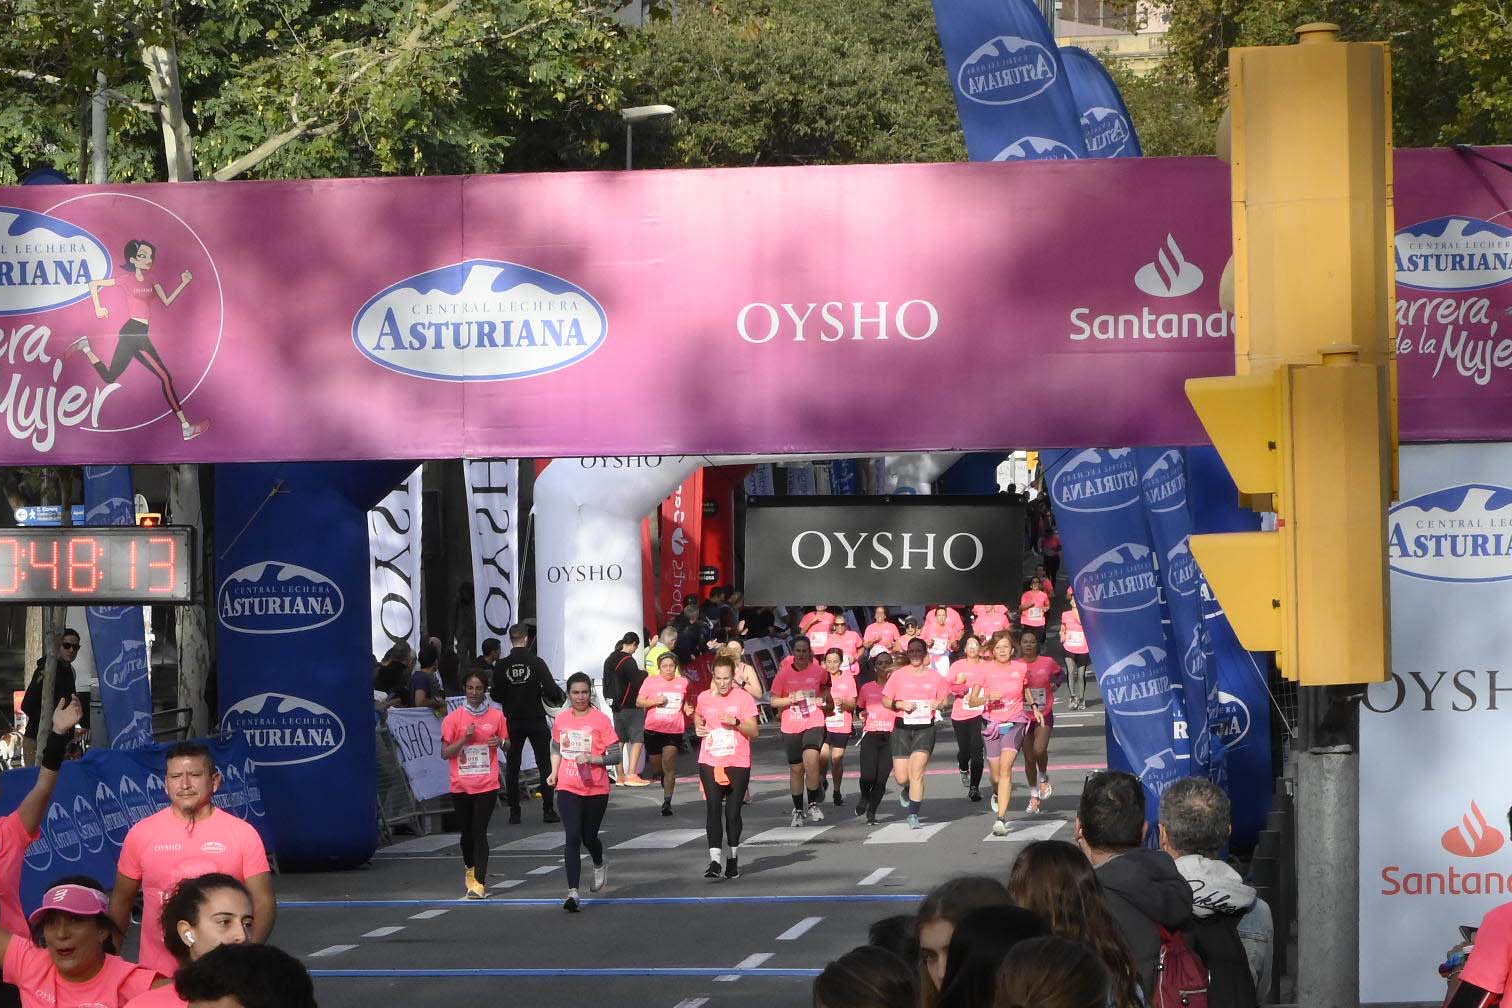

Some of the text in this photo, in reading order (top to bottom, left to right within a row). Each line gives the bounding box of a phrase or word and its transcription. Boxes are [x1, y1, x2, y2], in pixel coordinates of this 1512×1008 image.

[15, 242, 88, 254] LECHERA
[411, 300, 579, 315] CENTRAL LECHERA
[736, 300, 939, 344] OYSHO
[1395, 297, 1490, 326] arrera
[372, 307, 588, 352] ASTURIANA
[1419, 327, 1437, 354] la
[1432, 321, 1512, 386] Muje
[1416, 519, 1483, 529] CENTRAL
[791, 529, 984, 572] OYSHO
[547, 564, 623, 584] OYSHO
[222, 589, 335, 618] ASTURIANA
[233, 585, 331, 594] CENTRAL LECHERA
[512, 668, 525, 678] BP
[1361, 669, 1512, 714] OYSH
